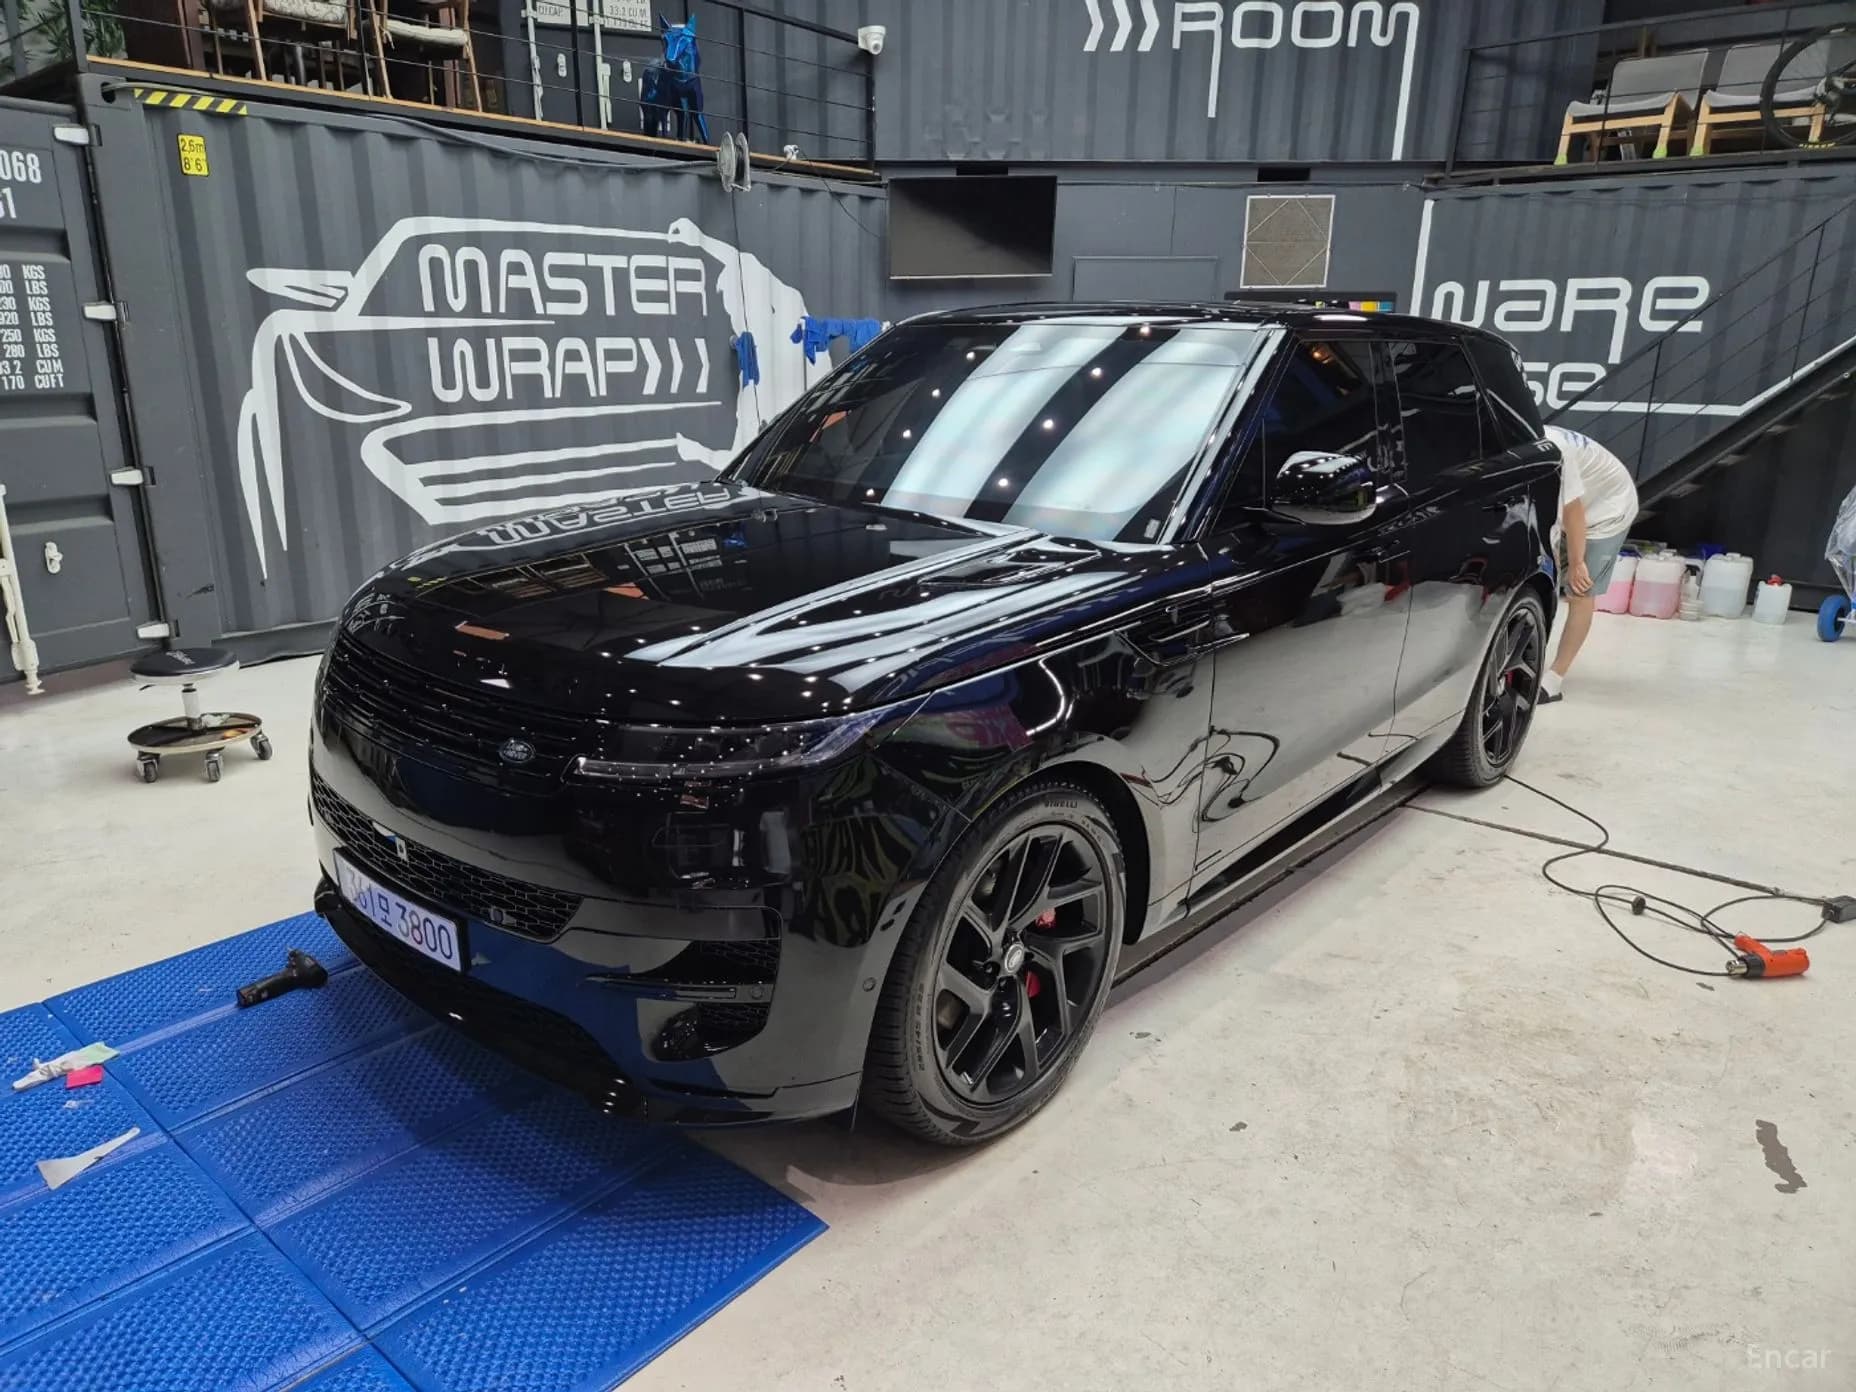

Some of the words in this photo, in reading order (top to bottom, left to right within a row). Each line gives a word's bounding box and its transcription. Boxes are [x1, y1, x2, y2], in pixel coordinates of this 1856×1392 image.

[0, 150, 42, 184] 068
[22, 264, 46, 280] KGS
[418, 243, 708, 316] MASTER
[25, 280, 48, 295] LBS
[28, 296, 51, 311] KGS
[31, 311, 53, 326] LBS
[33, 328, 56, 343] KGS
[36, 343, 59, 358] LBS
[427, 336, 638, 402] WRAP
[2, 375, 25, 390] 170
[1044, 800, 1078, 809] PIRELLI
